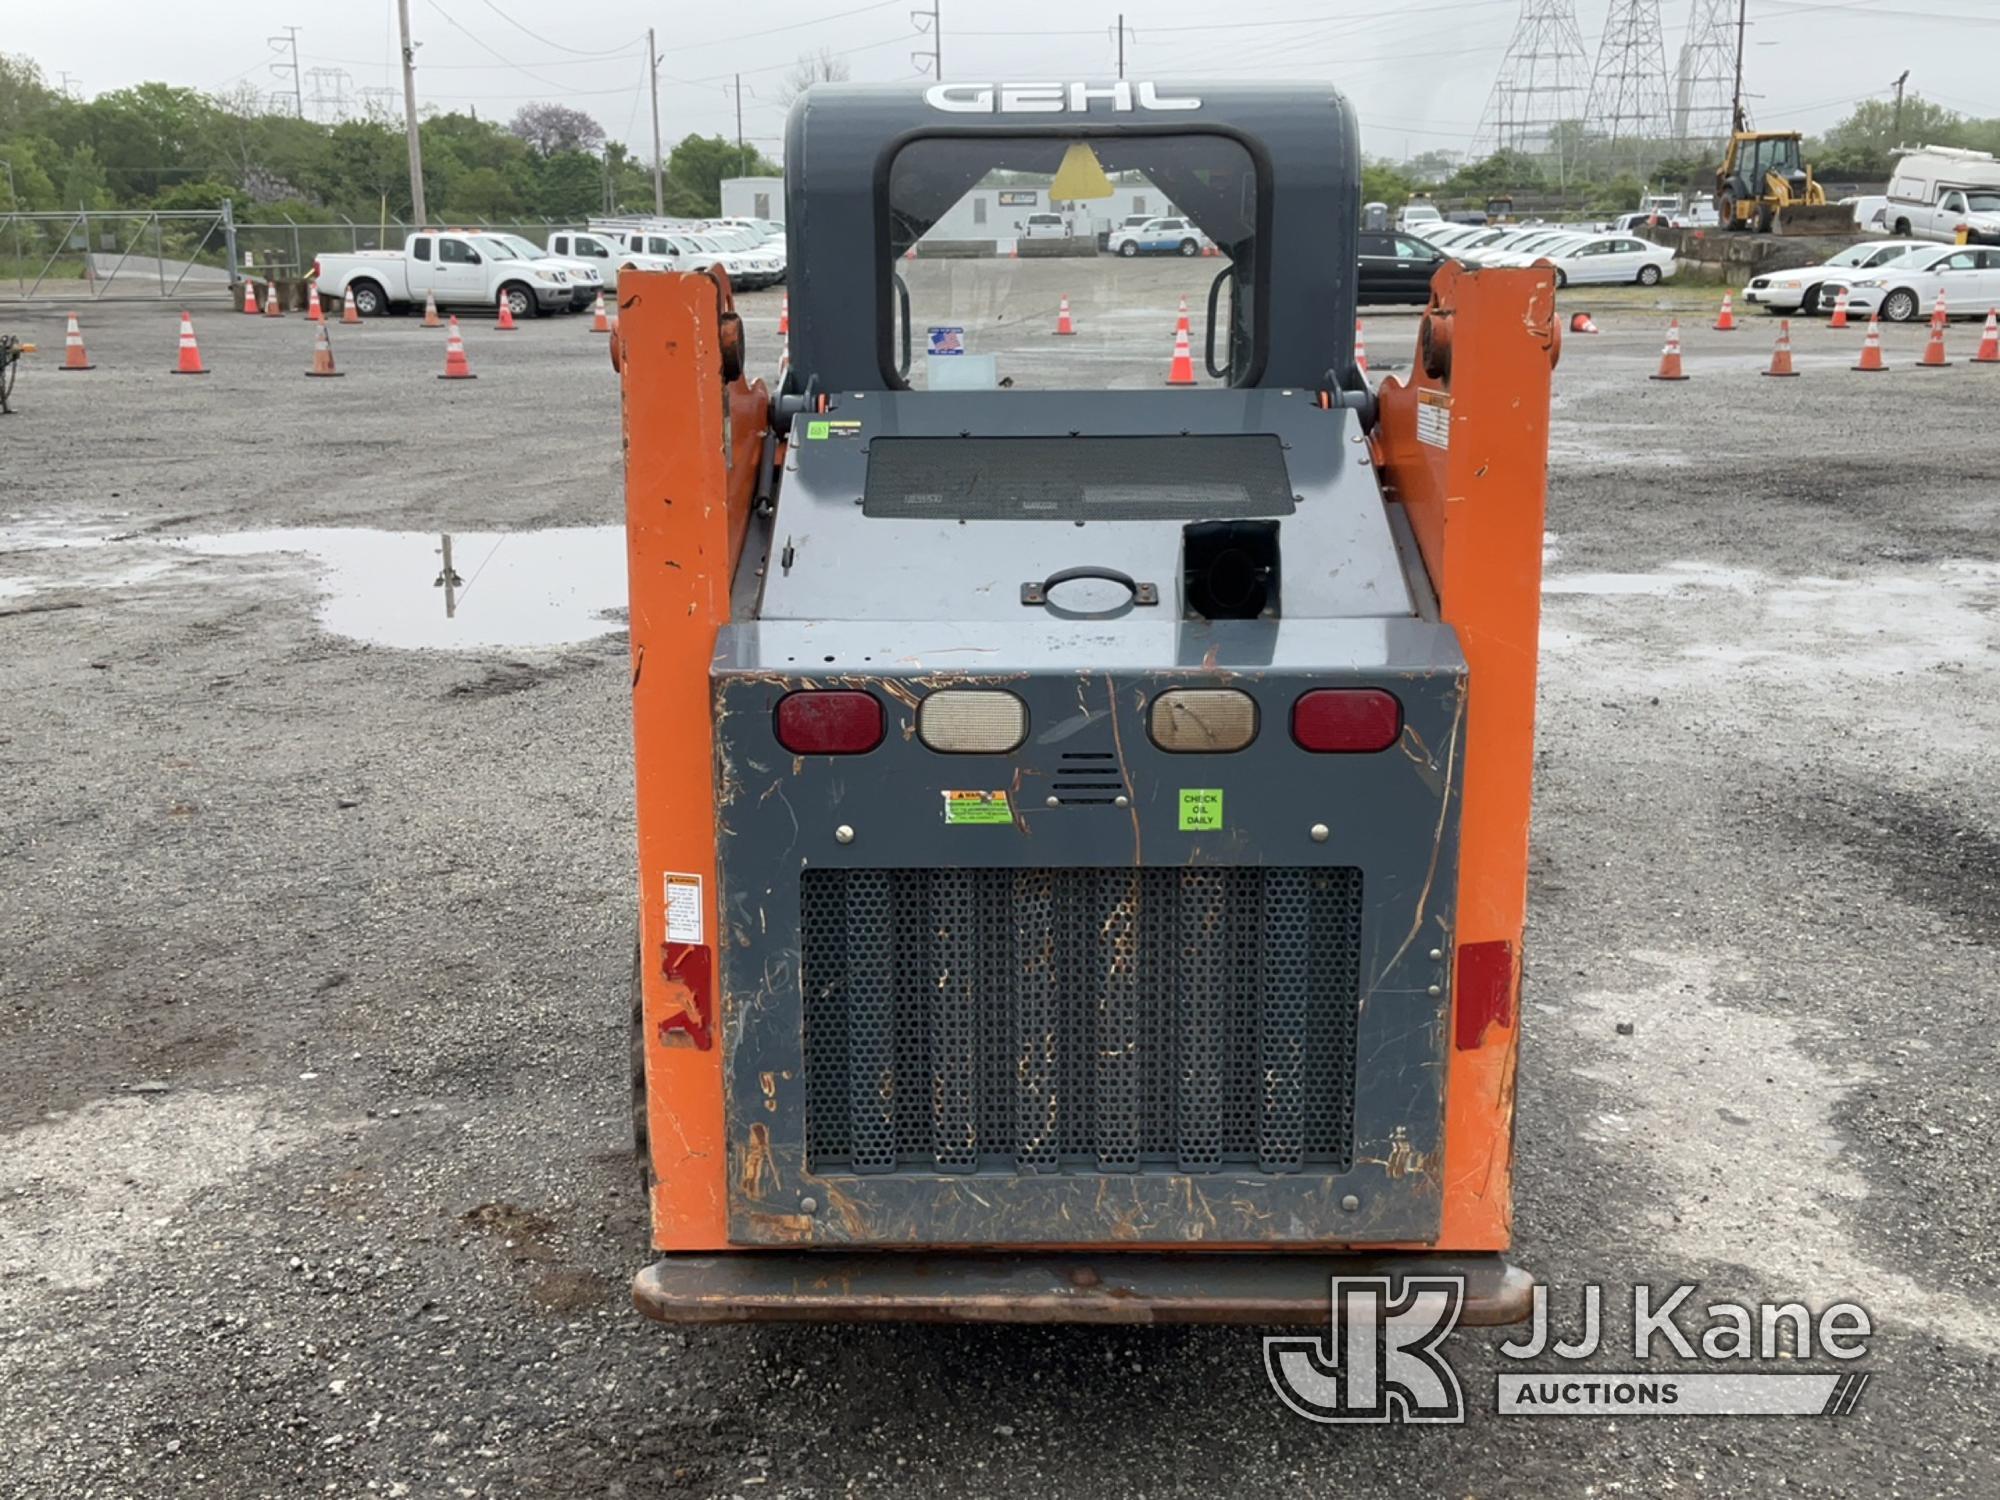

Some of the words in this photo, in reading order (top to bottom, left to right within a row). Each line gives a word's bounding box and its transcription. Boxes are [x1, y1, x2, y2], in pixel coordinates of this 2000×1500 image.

[925, 81, 1202, 113] GEHL
[1184, 795, 1217, 803] CHECK
[1192, 806, 1208, 814] OIL
